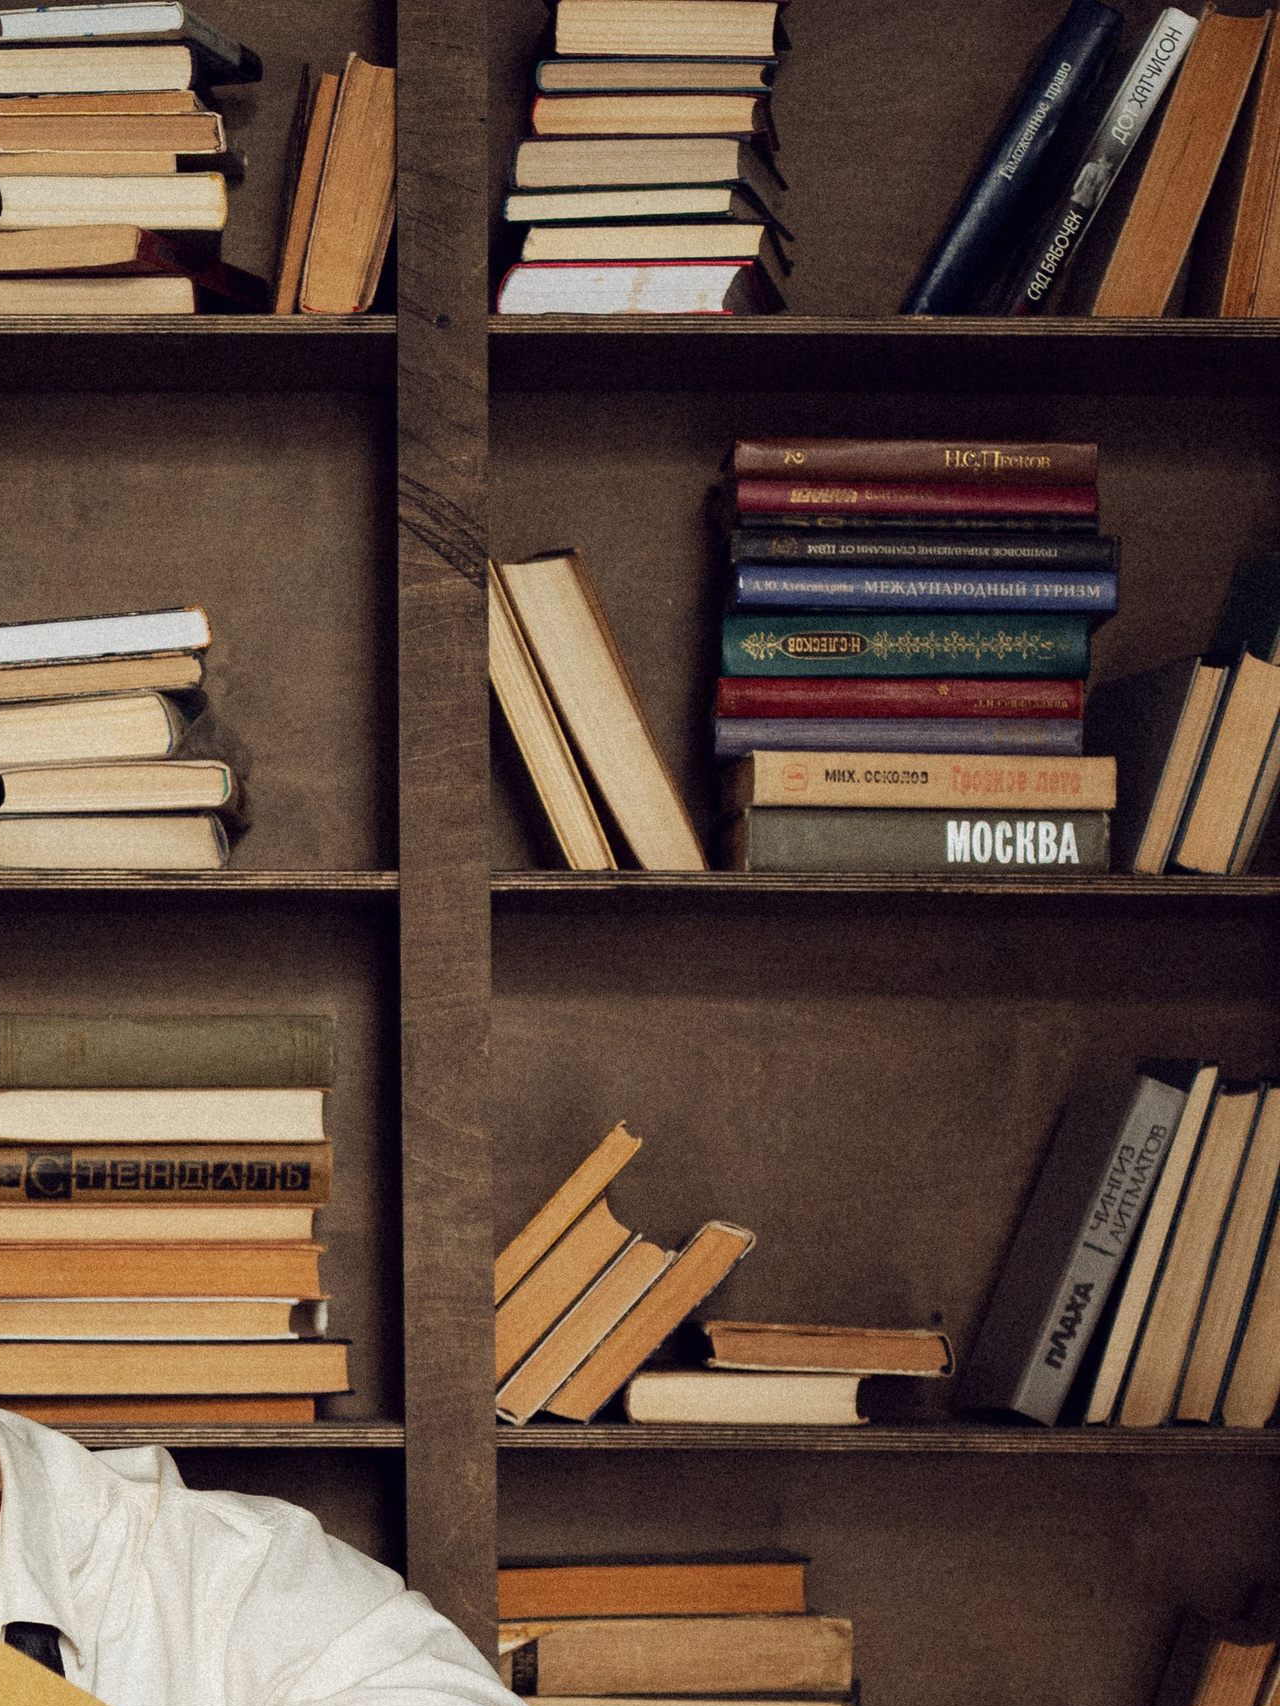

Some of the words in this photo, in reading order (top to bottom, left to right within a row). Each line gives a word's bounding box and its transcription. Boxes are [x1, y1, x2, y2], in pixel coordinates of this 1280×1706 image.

[998, 100, 1050, 183] Таможенное
[1047, 61, 1073, 103] право
[1027, 267, 1052, 302] САД
[1041, 209, 1083, 277] БАБОЧЕК
[1111, 107, 1139, 146] ДОТ
[1129, 26, 1183, 109] ХАТЧИСОН
[863, 579, 1027, 600] МЕЖДУНАРОДНЫЙ
[1033, 583, 1102, 600] ТУРИЗМ
[946, 819, 1081, 866] МОСКВА
[1089, 1144, 1136, 1232] ЧИНГИЗ
[1044, 1282, 1095, 1371] ПЛАХА
